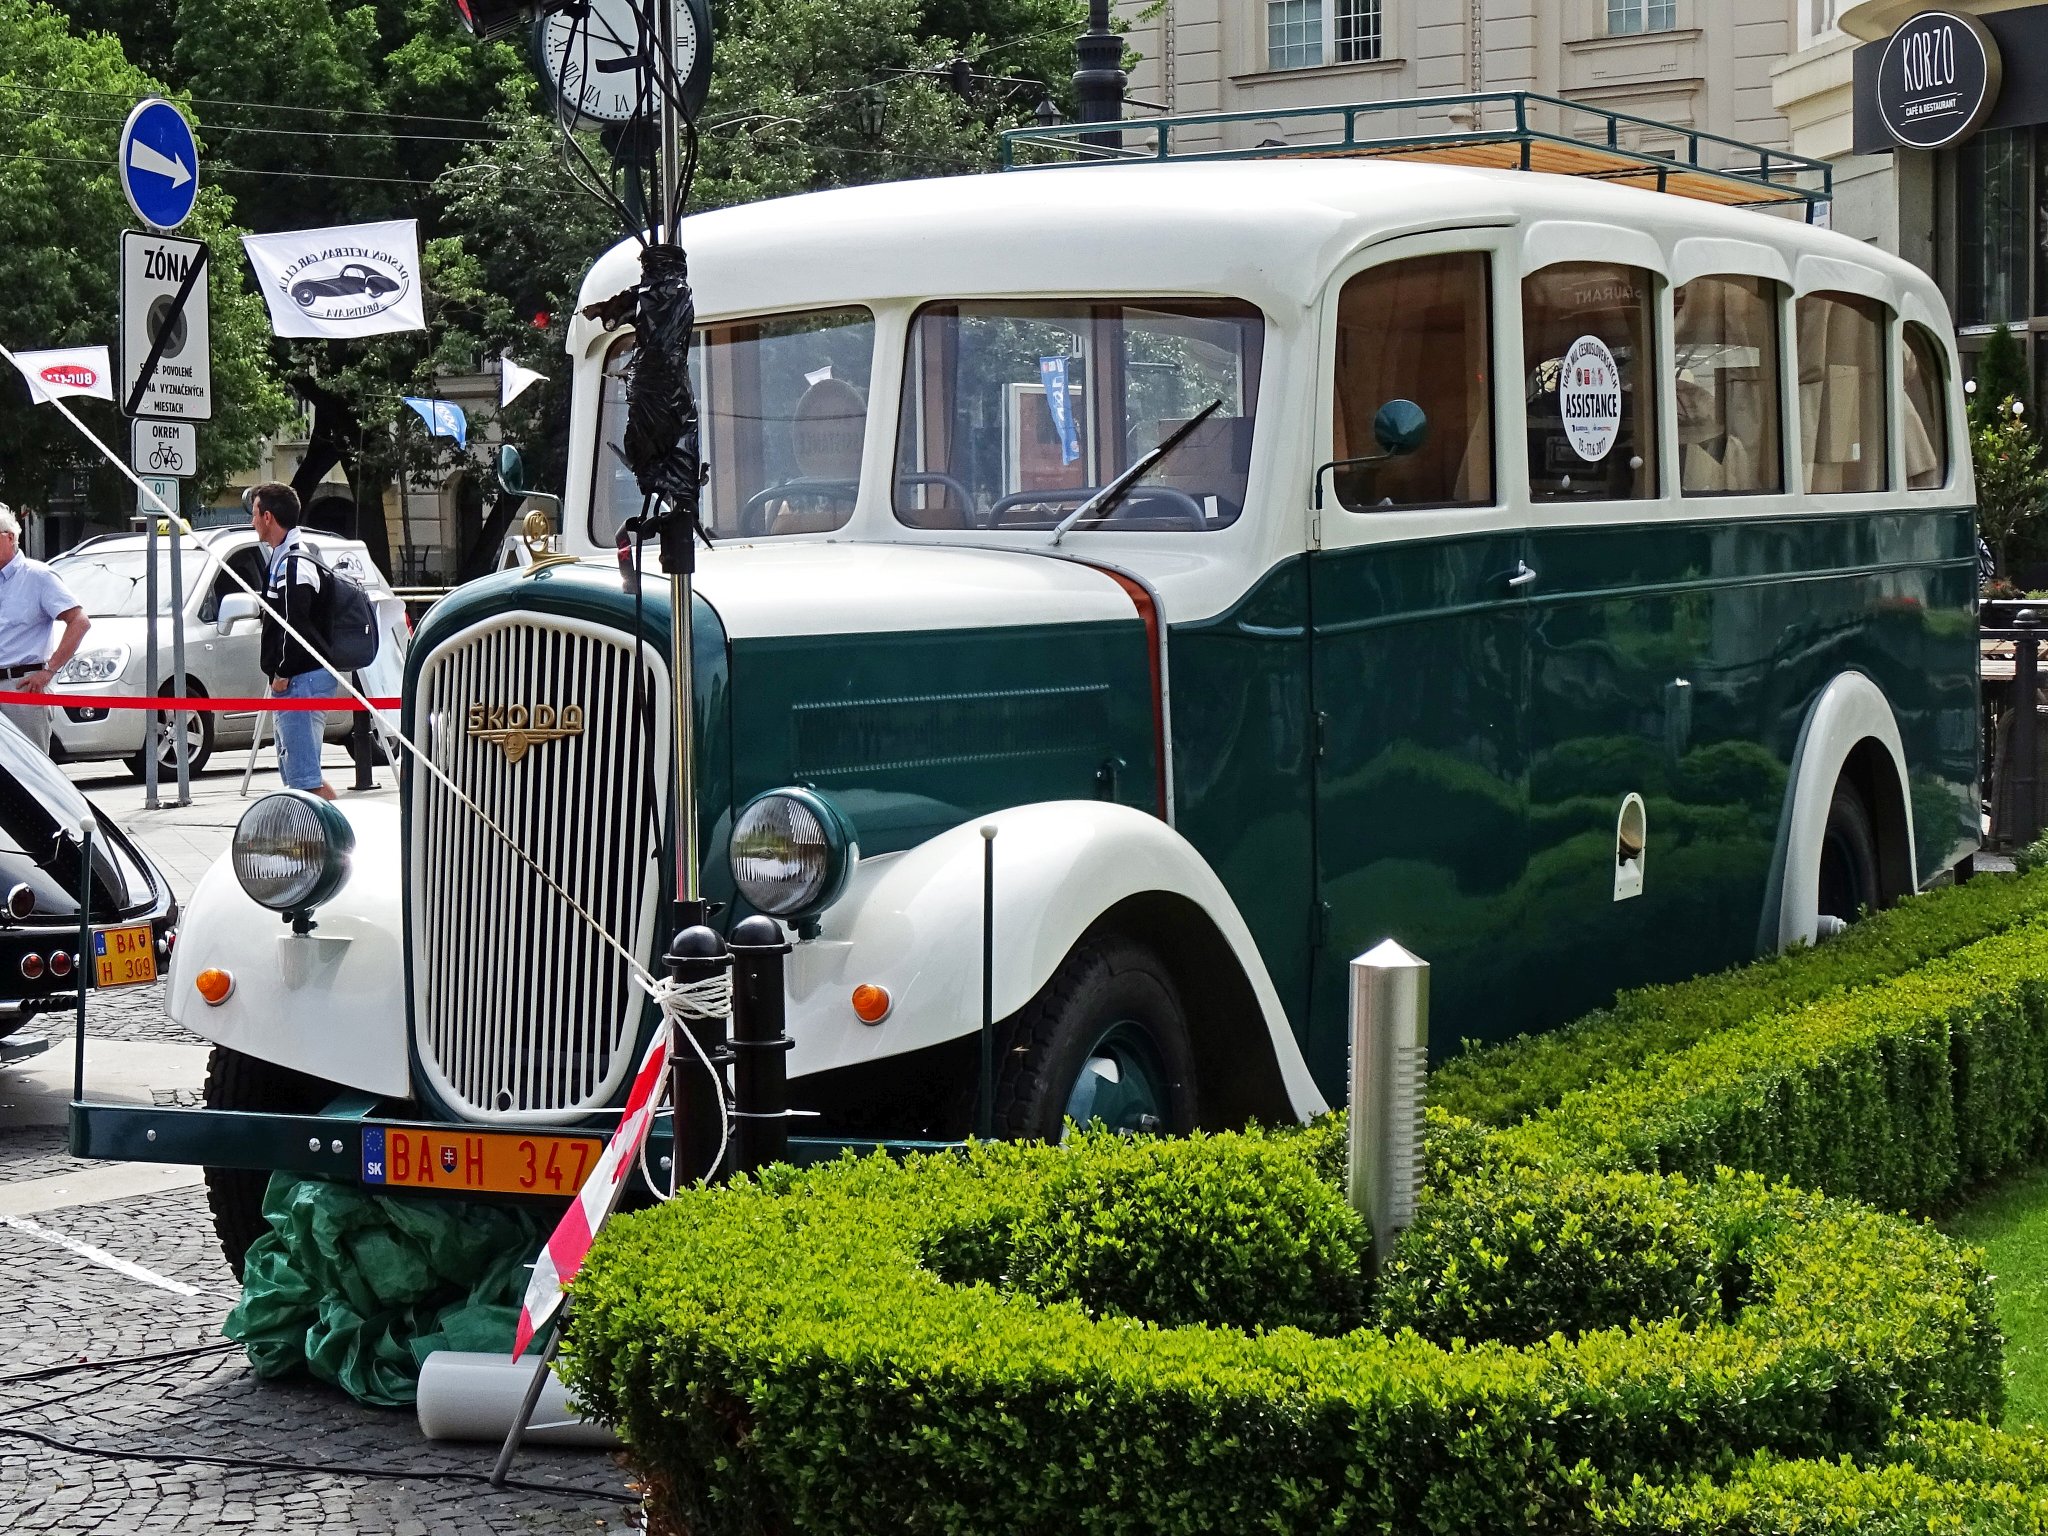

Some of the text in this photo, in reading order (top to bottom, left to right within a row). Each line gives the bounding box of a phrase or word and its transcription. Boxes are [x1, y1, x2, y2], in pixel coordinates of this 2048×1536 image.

[1902, 25, 1955, 92] KORZO
[614, 94, 630, 112] VI
[1906, 104, 1919, 116] CAFÉ
[1923, 98, 1956, 113] RESTAURANT
[144, 245, 190, 282] ZÓNA
[162, 365, 193, 378] POVOLENÉ
[160, 383, 204, 398] VYZNAČENÝCH
[154, 400, 184, 414] MIESTACH
[1565, 393, 1618, 418] ASSISTANCE
[152, 425, 180, 439] OKREM
[154, 482, 165, 495] 01
[468, 702, 583, 730] ŠKODA
[116, 933, 136, 953] BA
[103, 957, 151, 981] H 309
[367, 1162, 382, 1176] SK
[392, 1133, 589, 1192] BA H 347
